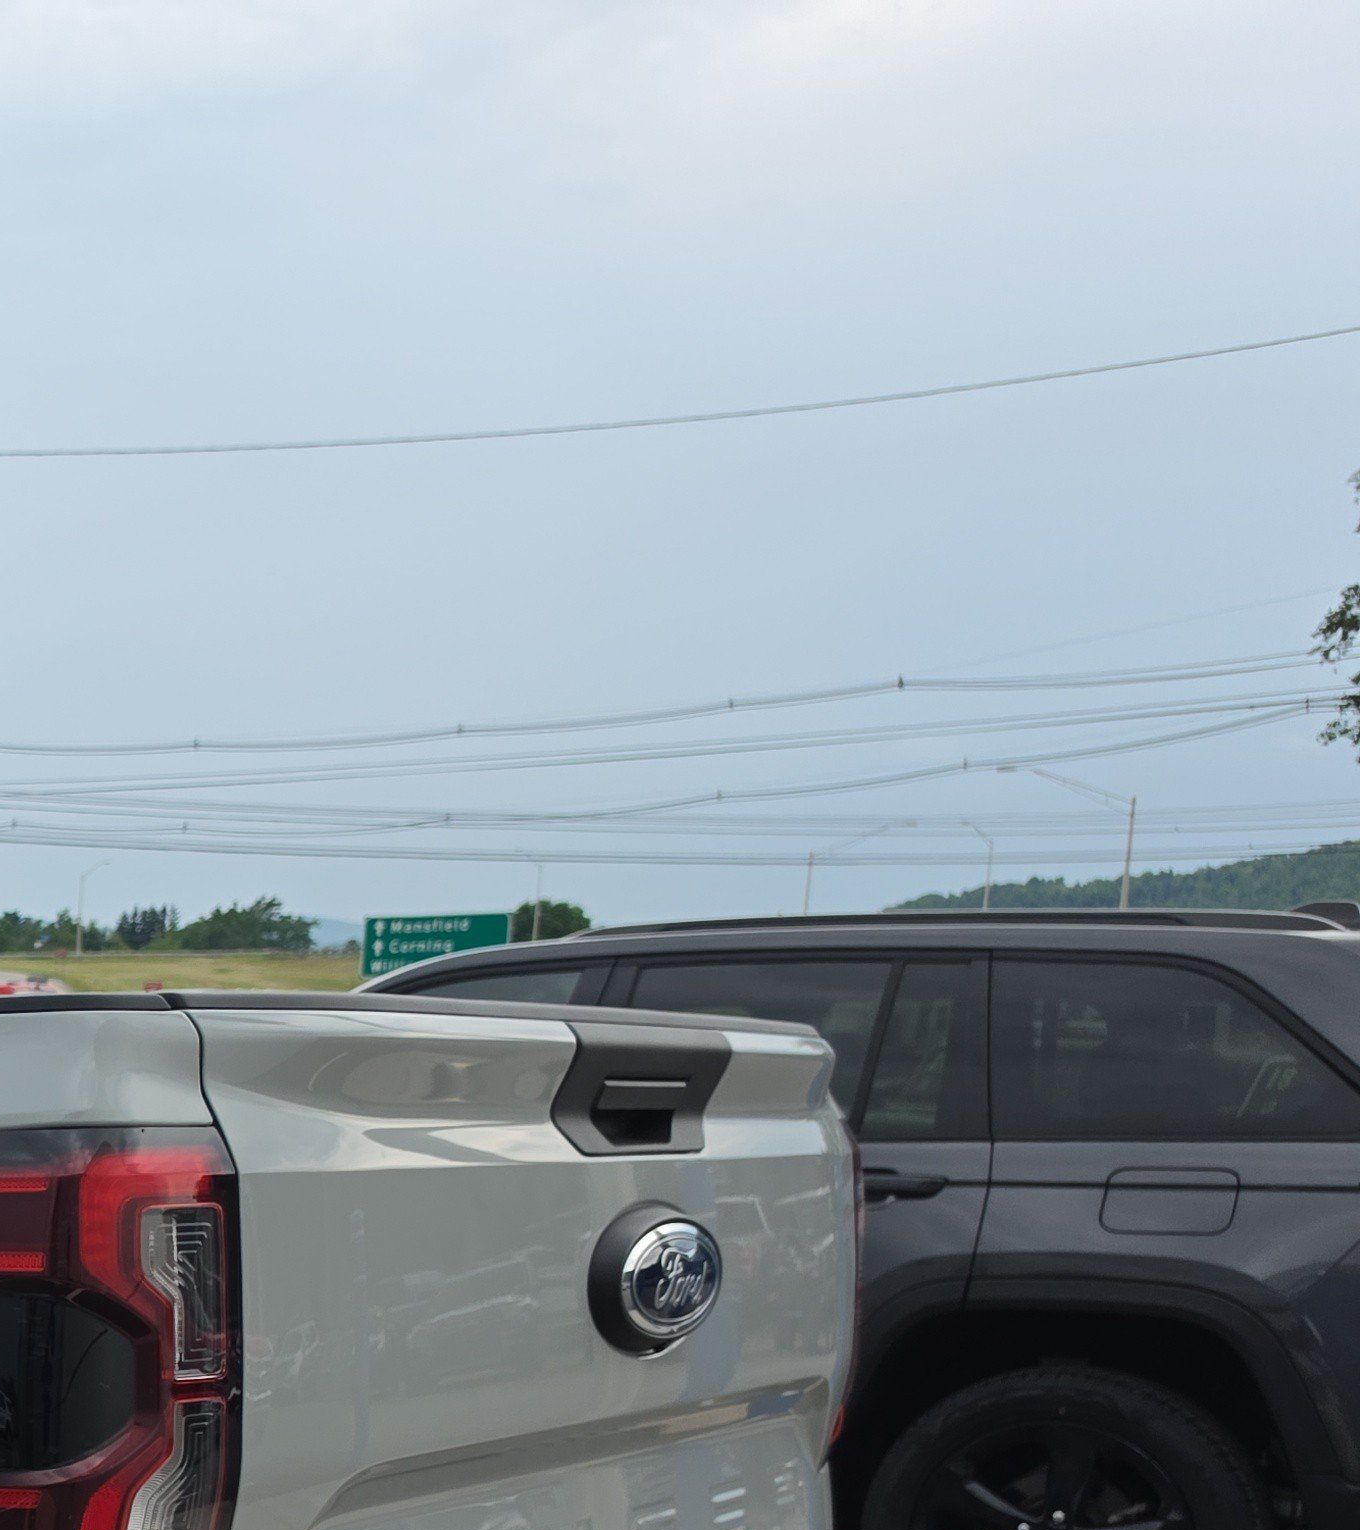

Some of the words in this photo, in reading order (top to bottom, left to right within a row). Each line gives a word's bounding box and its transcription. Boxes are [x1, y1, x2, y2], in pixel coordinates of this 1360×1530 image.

[390, 918, 472, 934] Mansfield
[389, 939, 455, 954] Corning
[653, 1246, 709, 1310] Ford
